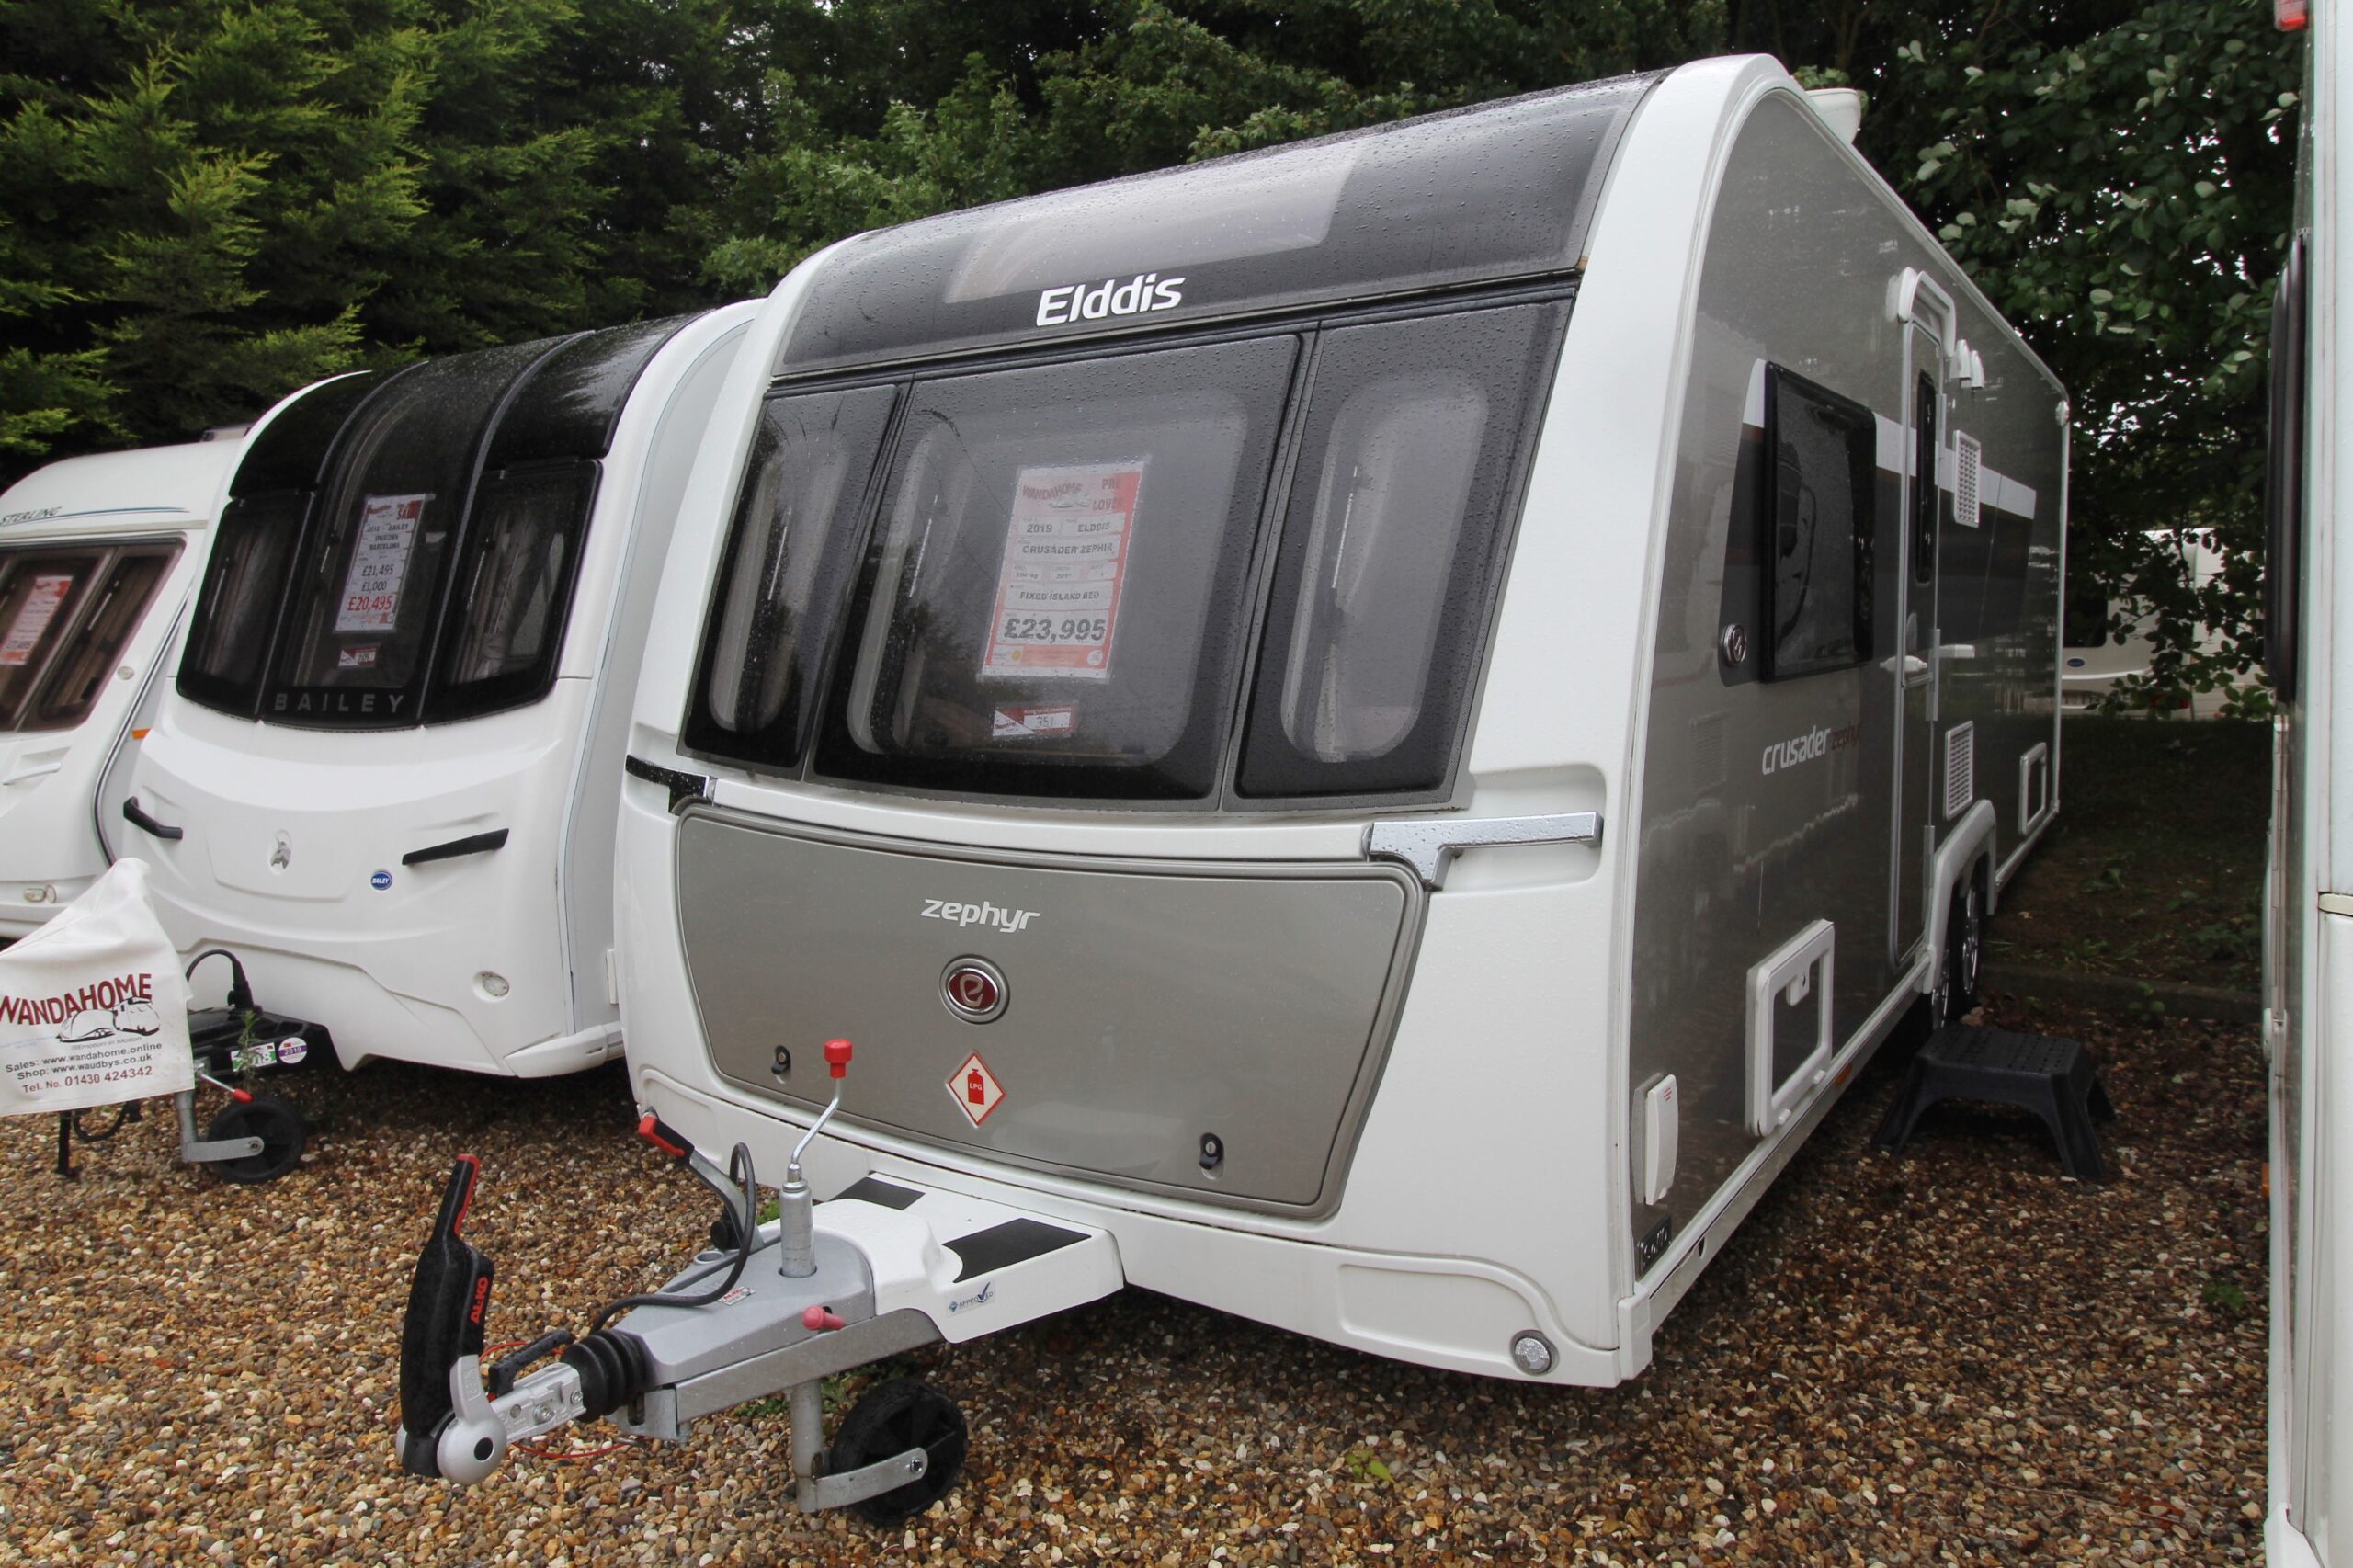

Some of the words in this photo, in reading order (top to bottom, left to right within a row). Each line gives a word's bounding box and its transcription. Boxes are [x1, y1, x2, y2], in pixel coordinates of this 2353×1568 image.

[1036, 273, 1186, 327] Elddis
[1026, 523, 1053, 533] 2019
[1022, 545, 1078, 554] CRUSADER
[361, 564, 395, 577] £21,495
[361, 581, 388, 594] £1,000
[1019, 592, 1047, 600] FIXED
[1082, 591, 1100, 599] BED
[347, 596, 393, 612] £20,495
[1004, 618, 1107, 644] £23,995
[274, 692, 404, 713] BAILEY
[1762, 724, 1831, 776] crusader
[921, 898, 1040, 934] zephyr
[0, 972, 153, 1026] WANDAHOME
[6, 1058, 40, 1074] Sales:
[42, 1041, 163, 1065] www.wandahome.online
[17, 1068, 49, 1081] Shop:
[51, 1052, 153, 1074] www.waudbys.co.uk
[23, 1081, 43, 1094] Tel.
[65, 1074, 100, 1087] 01430
[104, 1065, 153, 1082] 424342
[970, 1083, 983, 1091] LPG
